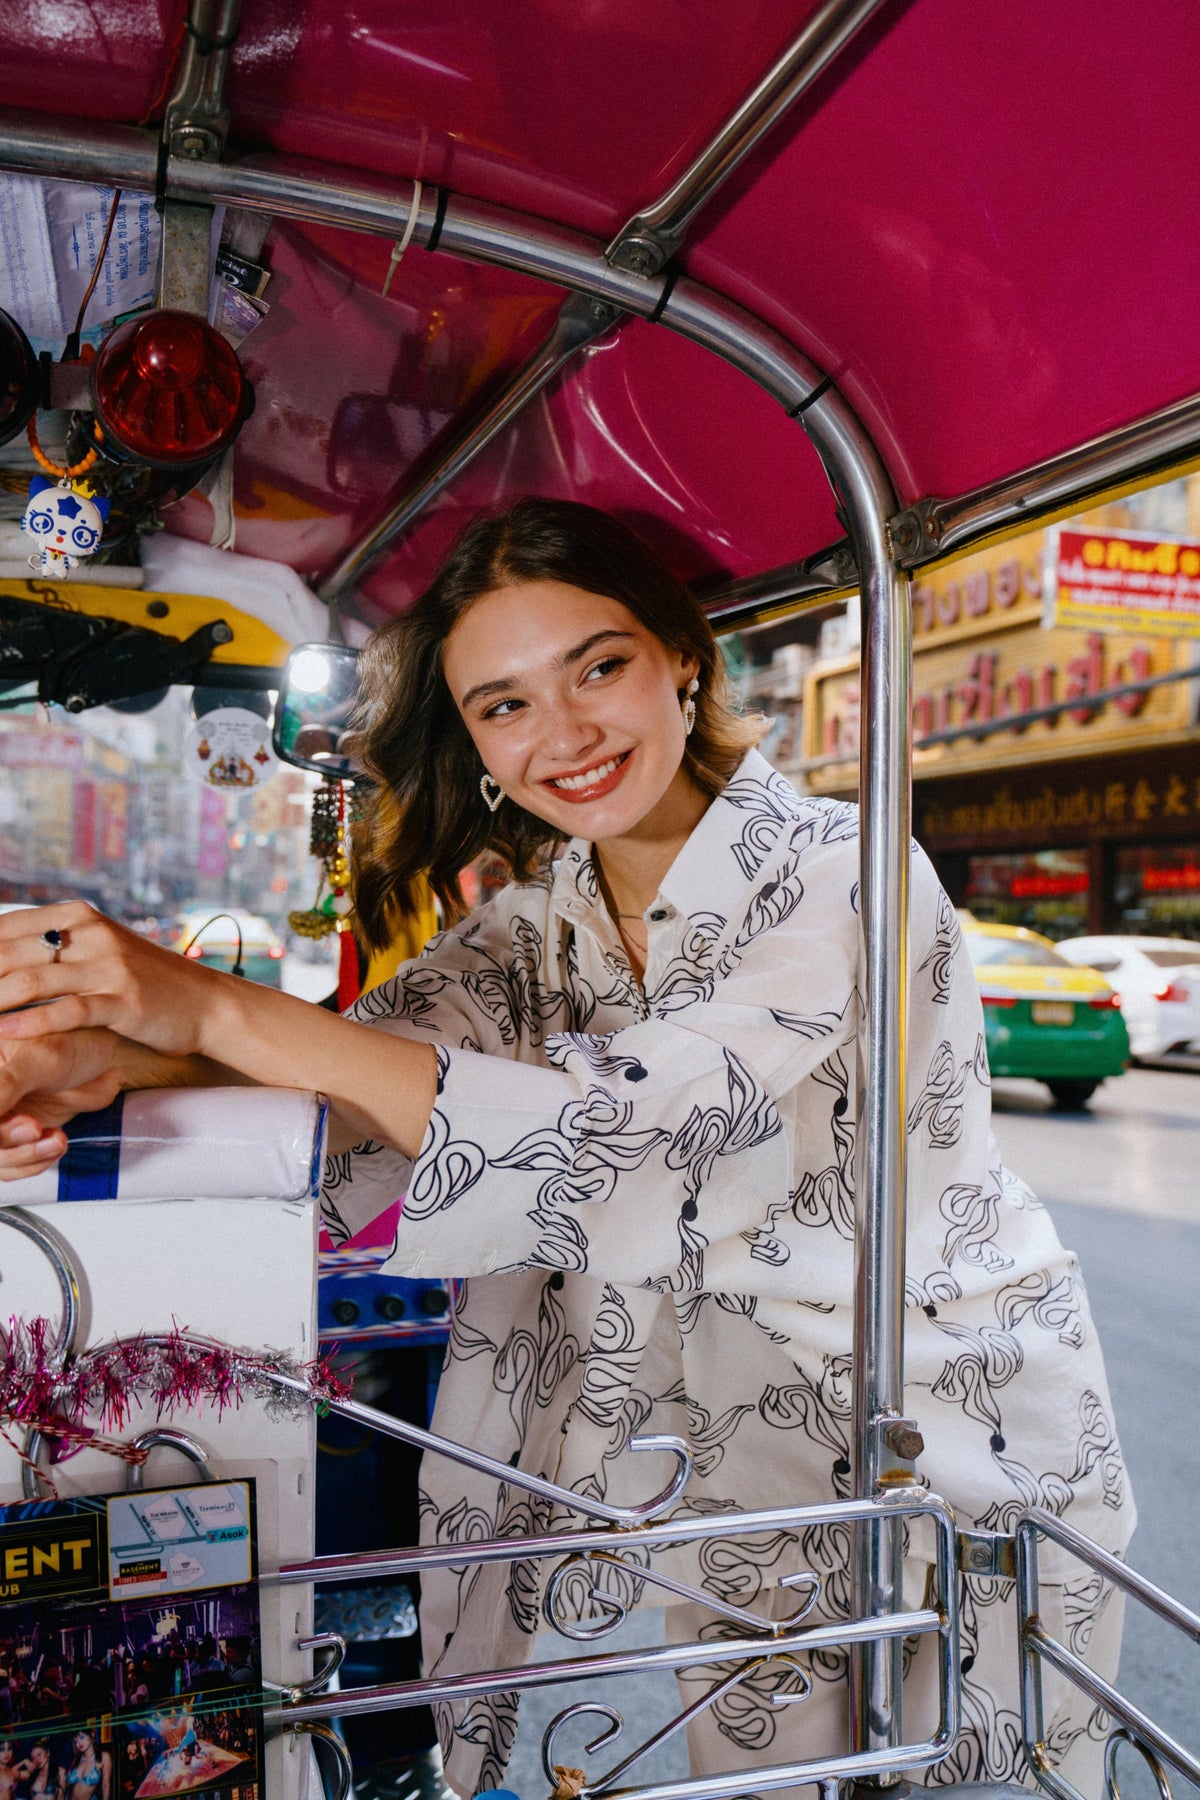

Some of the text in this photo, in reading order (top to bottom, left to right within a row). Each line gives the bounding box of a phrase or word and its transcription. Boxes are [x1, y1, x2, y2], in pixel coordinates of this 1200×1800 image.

[220, 1530, 244, 1540] Asok
[4, 1538, 92, 1580] ENT
[120, 1562, 160, 1575] BASEMENT
[117, 1575, 138, 1585] TIMES
